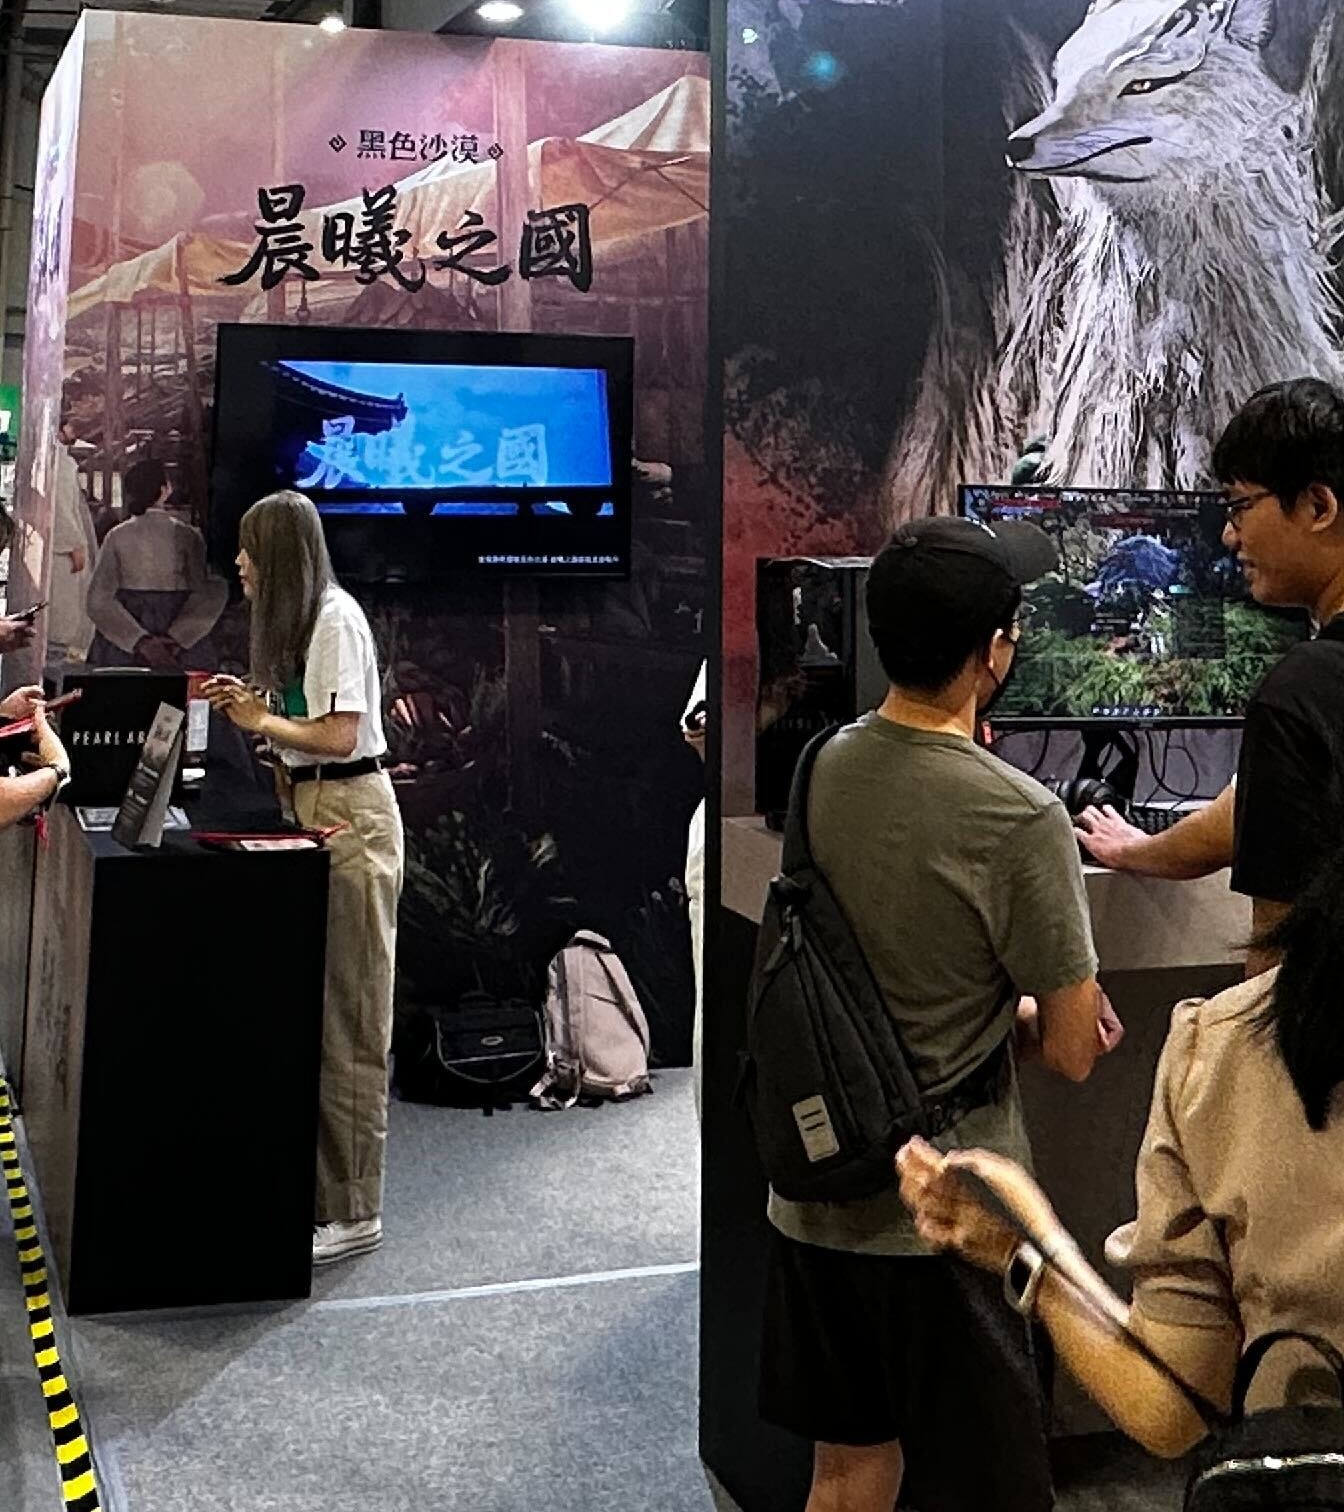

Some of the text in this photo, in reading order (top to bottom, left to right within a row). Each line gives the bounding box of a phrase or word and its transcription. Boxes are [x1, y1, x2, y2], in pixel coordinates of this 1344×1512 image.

[356, 129, 480, 165] 黑色沙漠
[218, 185, 592, 294] 晨曦之國
